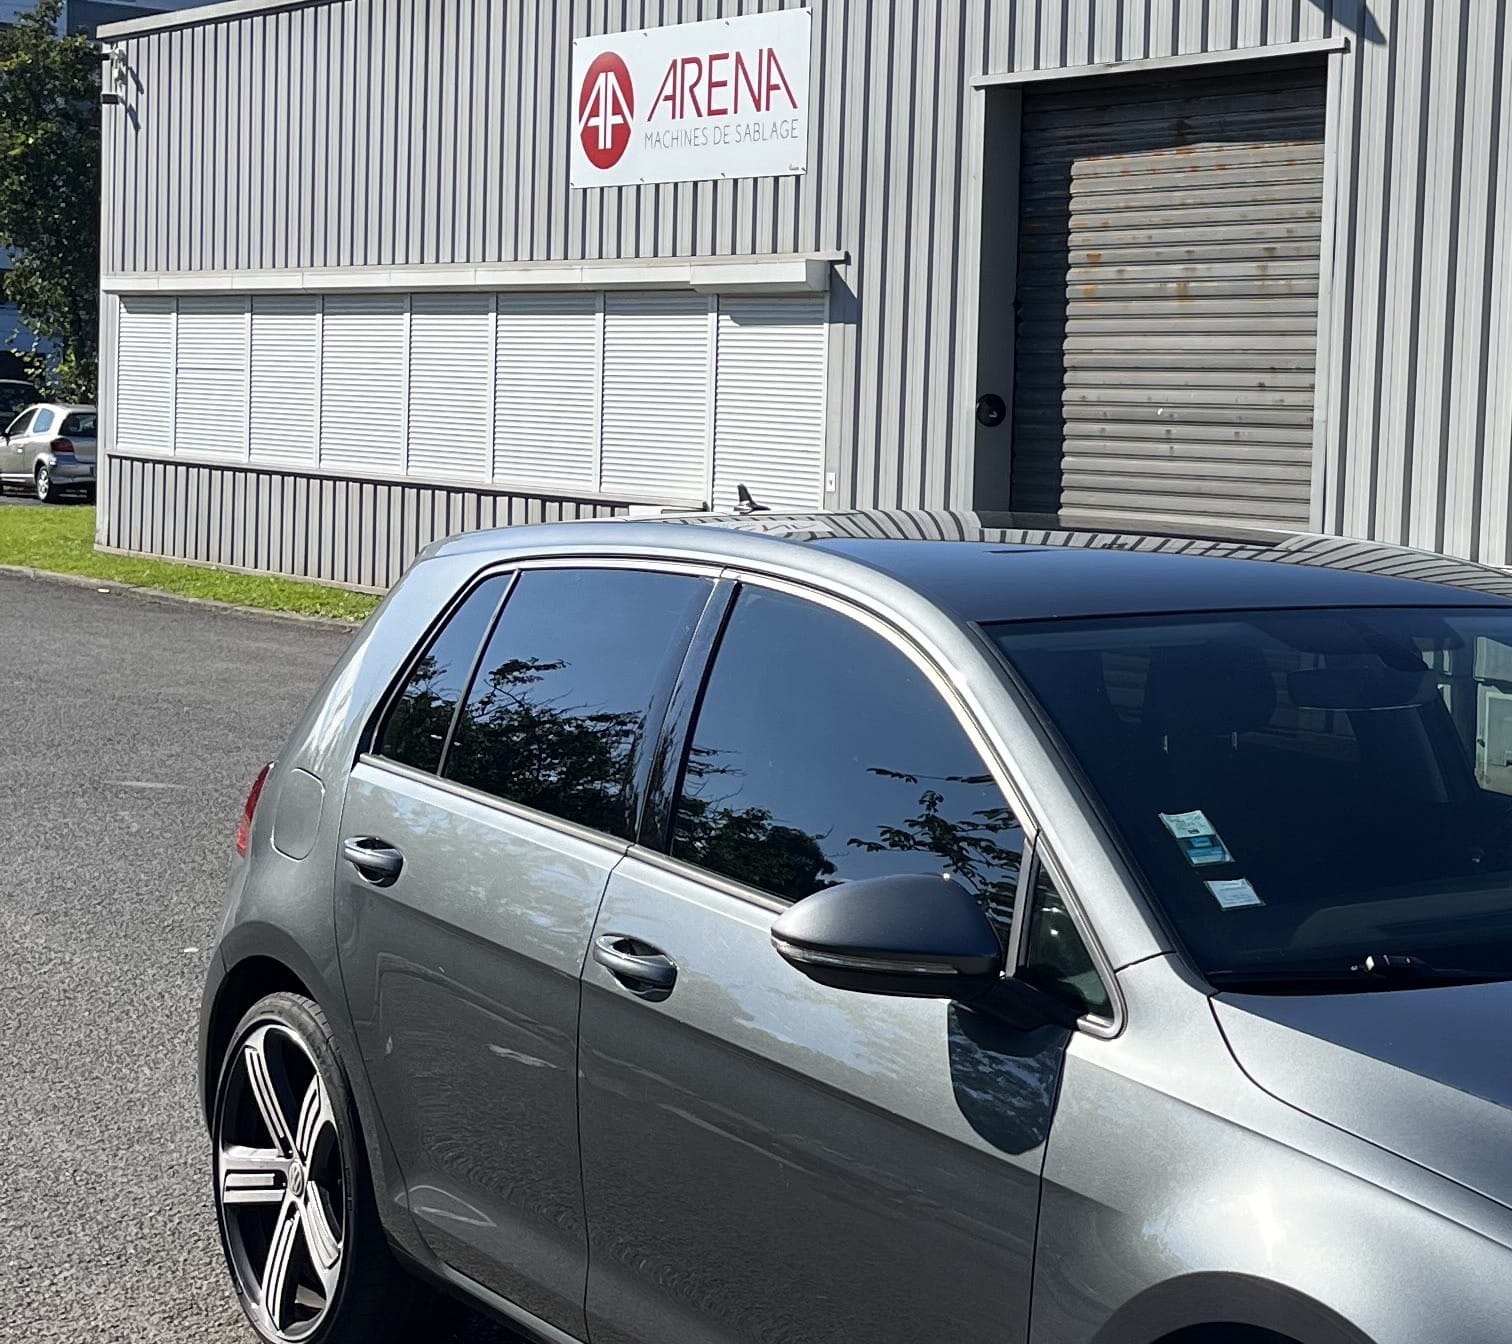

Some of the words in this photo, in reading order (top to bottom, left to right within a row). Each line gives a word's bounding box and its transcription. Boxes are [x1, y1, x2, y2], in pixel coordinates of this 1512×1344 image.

[647, 47, 799, 122] ARENA
[644, 128, 709, 150] MACHINES
[713, 124, 731, 145] DE
[735, 118, 799, 143] SABLAGE
